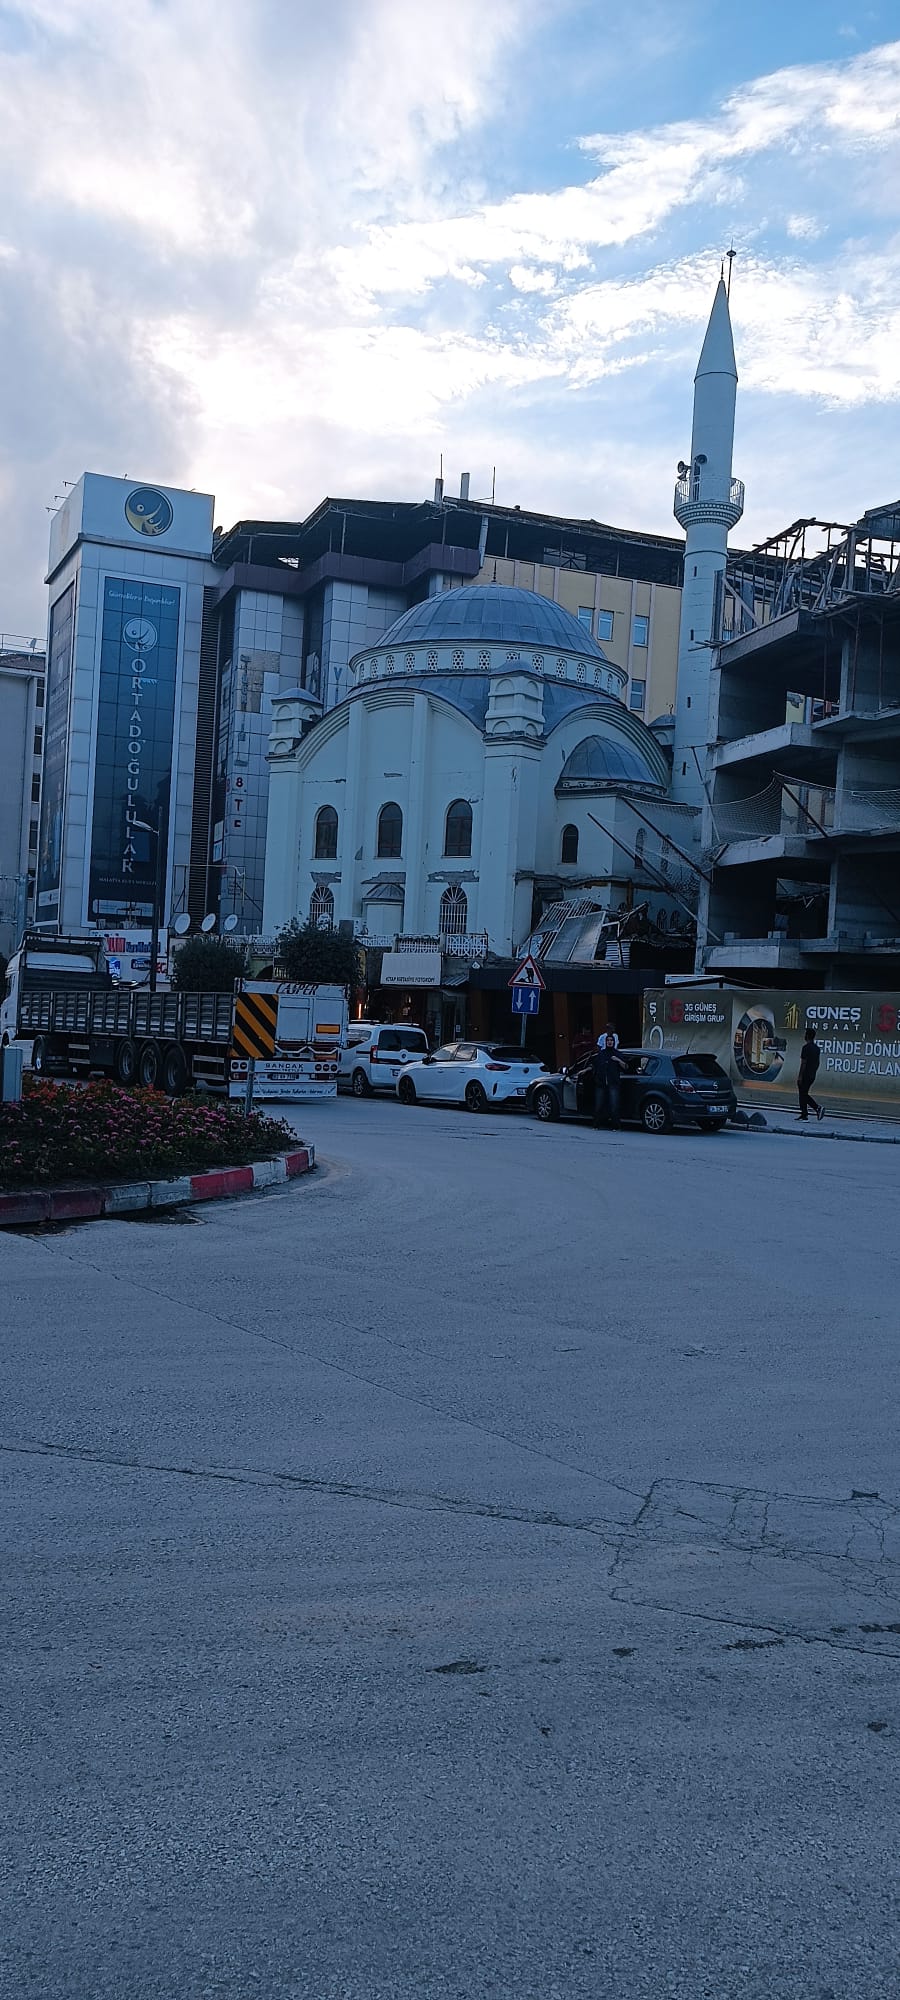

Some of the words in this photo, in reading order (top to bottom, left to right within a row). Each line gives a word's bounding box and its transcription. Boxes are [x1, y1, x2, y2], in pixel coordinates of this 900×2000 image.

[684, 1003, 693, 1011] 3G
[694, 1002, 717, 1013] GÜNEŞ
[806, 1005, 862, 1023] GÜNEŞ
[684, 1013, 706, 1023] GİRİŞİM
[707, 1014, 725, 1022] GRUP
[826, 1057, 866, 1074] PROJE
